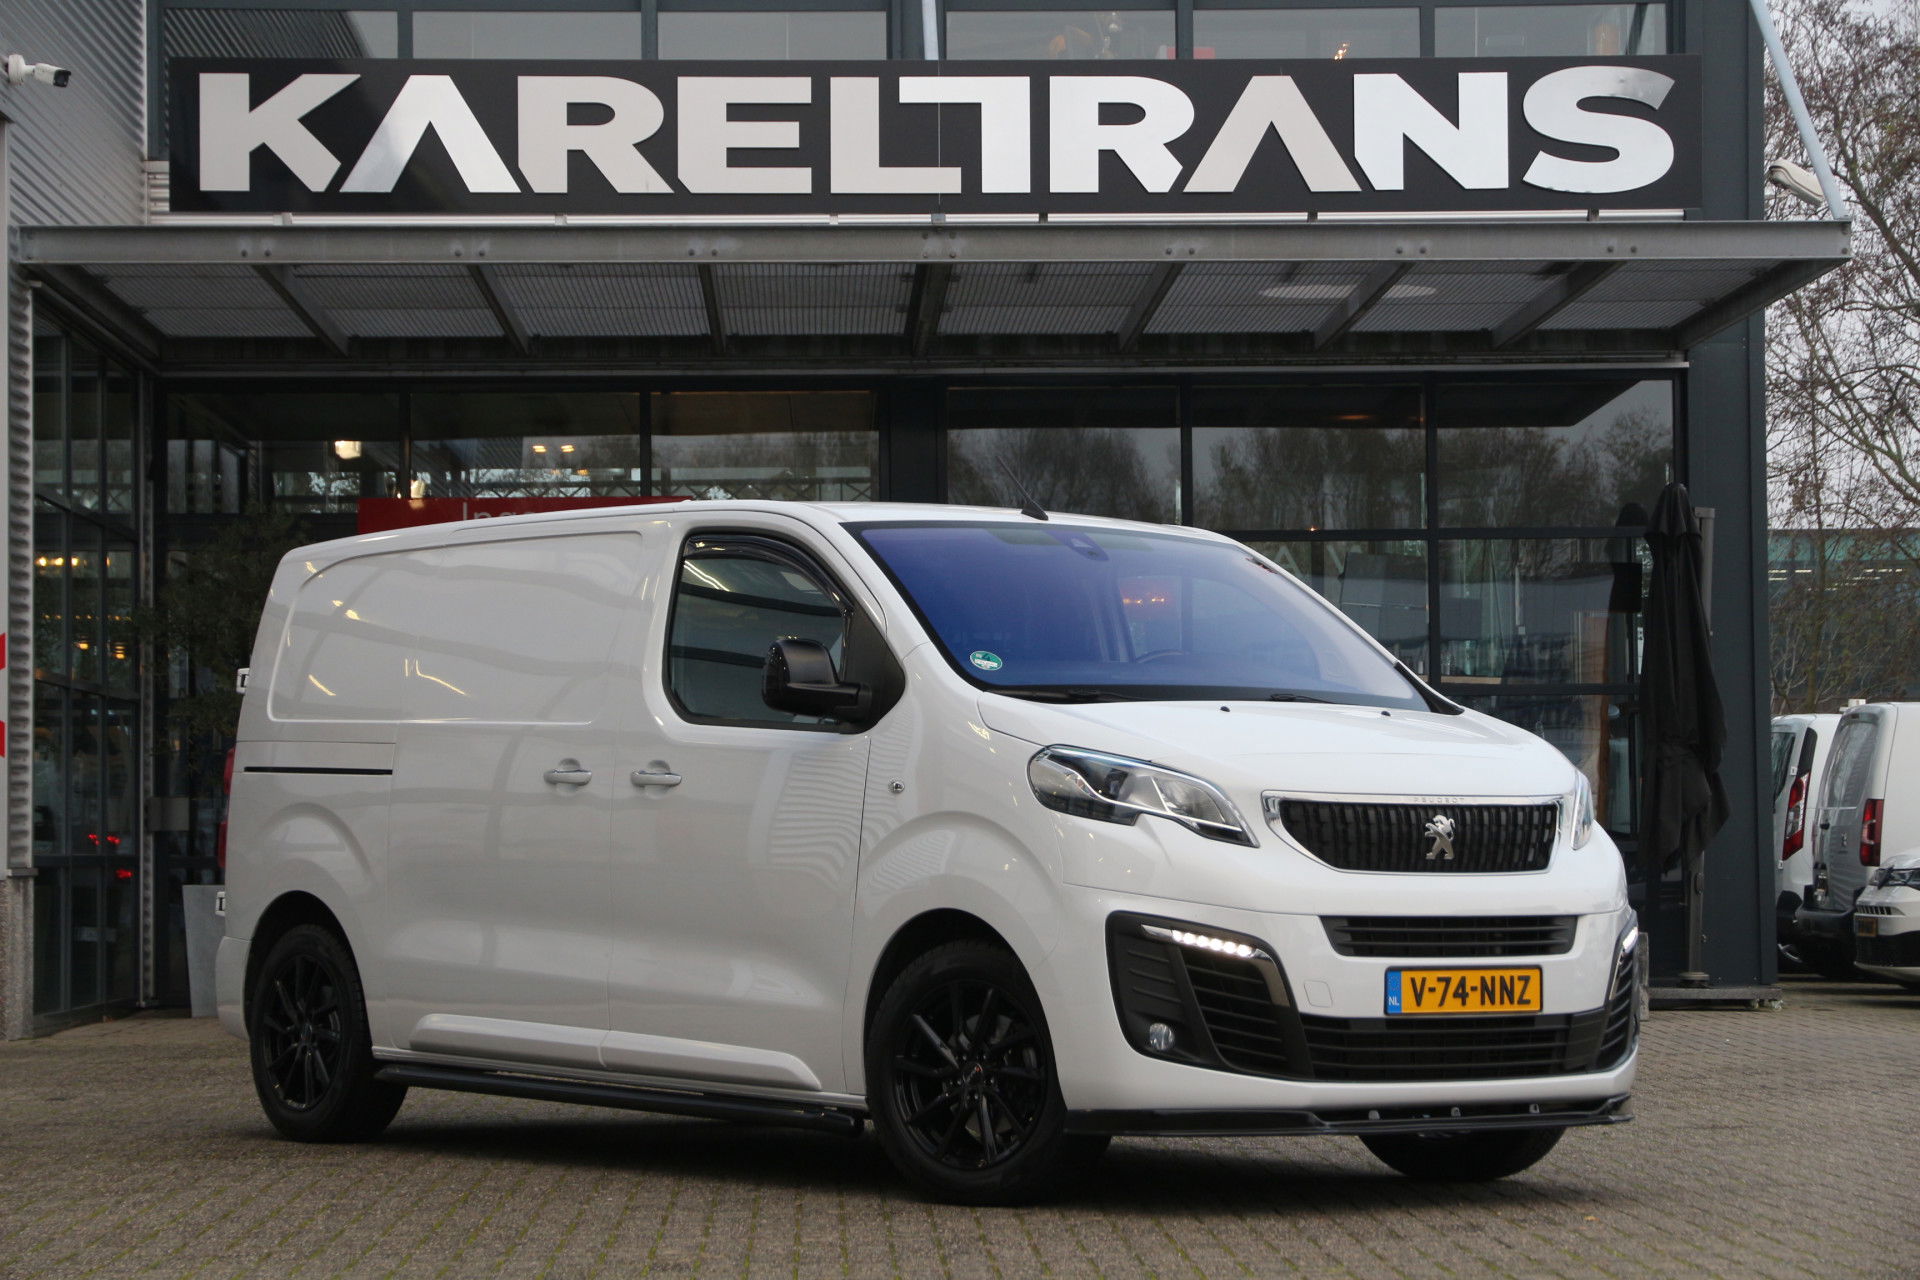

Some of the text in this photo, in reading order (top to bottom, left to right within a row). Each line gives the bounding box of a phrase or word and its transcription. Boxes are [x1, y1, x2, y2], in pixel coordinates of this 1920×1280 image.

[198, 65, 1676, 194] KARELTRANS
[1414, 796, 1465, 804] PEUGEOT
[1388, 996, 1400, 1006] NL
[1410, 975, 1532, 1008] V-74-NNZ
